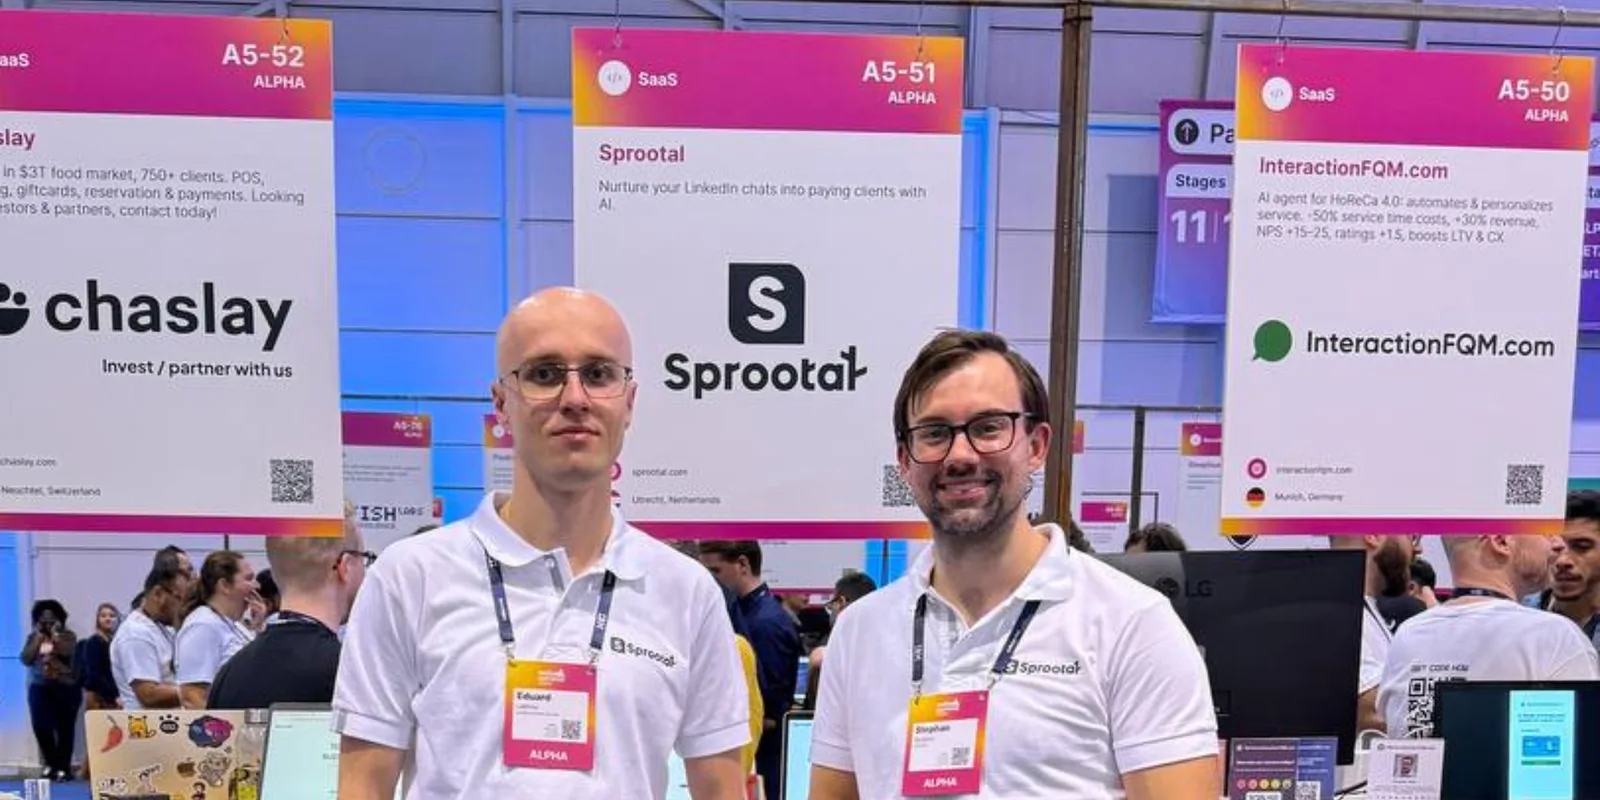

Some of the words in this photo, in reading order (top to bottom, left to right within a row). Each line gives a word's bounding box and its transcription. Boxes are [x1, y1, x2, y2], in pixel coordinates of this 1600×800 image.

[221, 43, 305, 67] A5-52
[638, 71, 678, 87] SaaS
[862, 60, 936, 84] A5-51
[253, 75, 306, 89] ALPHA
[1498, 79, 1571, 102] A5-50
[888, 90, 937, 105] ALPHA
[1299, 86, 1335, 102] SaaS
[1524, 108, 1569, 123] ALPHA
[599, 144, 686, 164] Sprootal
[20, 165, 45, 179] $3T
[51, 165, 82, 179] food
[86, 168, 137, 182] market,
[140, 168, 174, 182] 750+
[180, 169, 228, 183] clients.
[232, 170, 265, 187] POS,
[1259, 157, 1449, 179] InteractionFQM.com
[598, 180, 650, 194] Nurture
[652, 182, 681, 197] your
[684, 182, 739, 195] LinkedIn
[741, 184, 778, 196] chats
[780, 184, 806, 196] into
[808, 185, 851, 200] paying
[853, 185, 896, 198] clients
[899, 185, 927, 198] with
[1175, 174, 1227, 191] Stages
[16, 183, 80, 199] giftcards,
[85, 186, 160, 200] reservation
[165, 186, 174, 200] &
[178, 188, 248, 202] payments.
[251, 188, 304, 206] Looking
[1257, 192, 1270, 204] AI
[1273, 194, 1308, 207] agent
[1310, 193, 1328, 205] for
[1330, 194, 1379, 207] HoReCa
[1406, 197, 1469, 209] automates
[1470, 198, 1479, 210] &
[1481, 200, 1554, 212] personalizes
[0, 202, 38, 215] stors
[41, 201, 50, 215] &
[54, 203, 116, 218] partners,
[119, 206, 171, 218] contact
[175, 206, 218, 220] today!
[1341, 212, 1384, 224] service
[1387, 212, 1413, 224] time
[1415, 214, 1451, 227] costs,
[1455, 213, 1487, 227] +30%
[1171, 209, 1206, 243] 11
[1256, 225, 1283, 238] NPS
[1334, 228, 1376, 243] ratings
[1408, 230, 1449, 242] boosts
[1451, 231, 1474, 243] LTV
[1475, 231, 1485, 243] &
[1487, 231, 1505, 244] CX
[747, 275, 787, 333] S
[44, 279, 293, 352] chaslay
[1306, 330, 1556, 358] InteractionFQM.com
[102, 359, 154, 375] Invest
[157, 361, 165, 376] /
[169, 362, 231, 378] partner
[233, 361, 271, 377] with
[273, 366, 293, 378] us
[663, 345, 868, 400] Sprootal
[631, 468, 689, 479] sprootal.com
[632, 495, 667, 506] Utrecht,
[669, 495, 721, 506] Netherlands
[1274, 491, 1306, 502] Munich,
[1308, 492, 1344, 503] Germany
[355, 505, 397, 522] ISH
[1184, 580, 1213, 598] LG
[516, 691, 552, 702] Eduard
[529, 749, 568, 762] ALPHA
[923, 777, 957, 789] ALPHA
